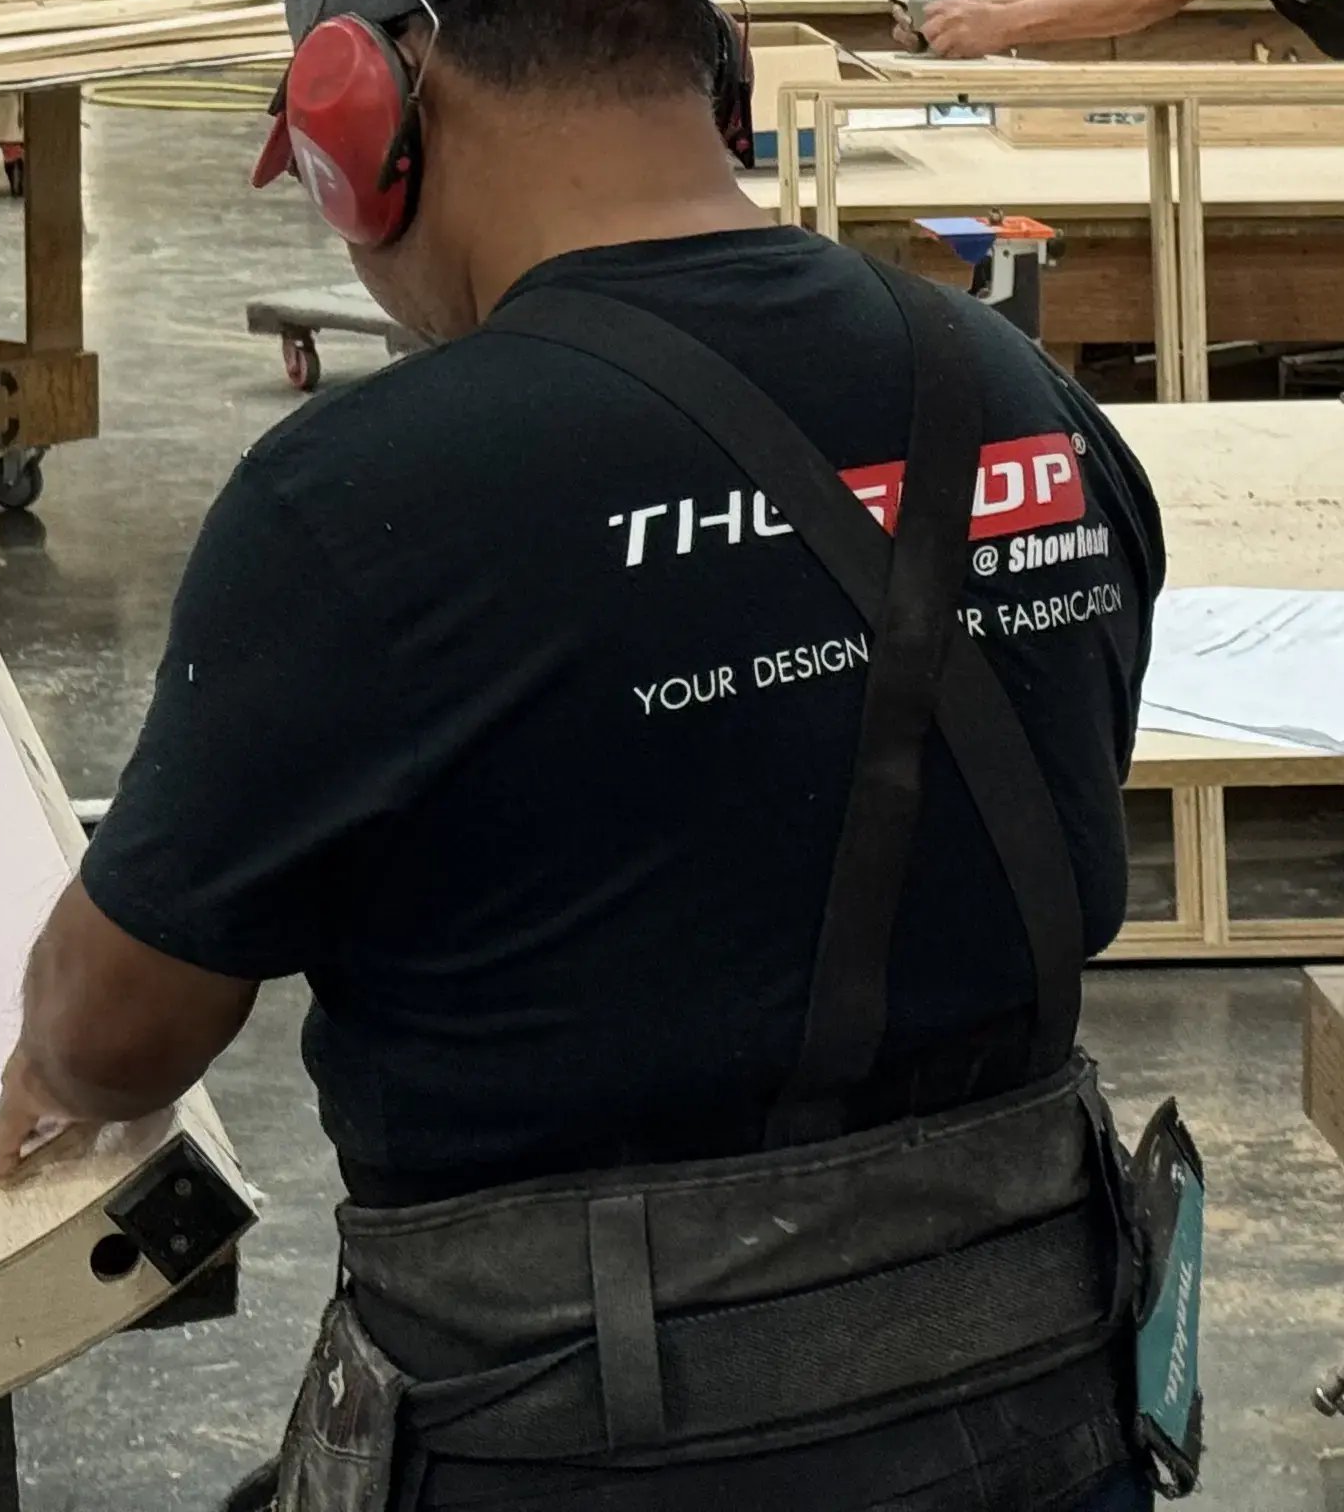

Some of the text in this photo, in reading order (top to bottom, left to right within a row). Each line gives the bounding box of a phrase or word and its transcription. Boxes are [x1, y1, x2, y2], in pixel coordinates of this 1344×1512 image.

[1009, 523, 1109, 573] ShowReady
[634, 666, 737, 716] YOUR
[754, 632, 870, 688] DESIGN
[997, 584, 1123, 636] FABRICATION
